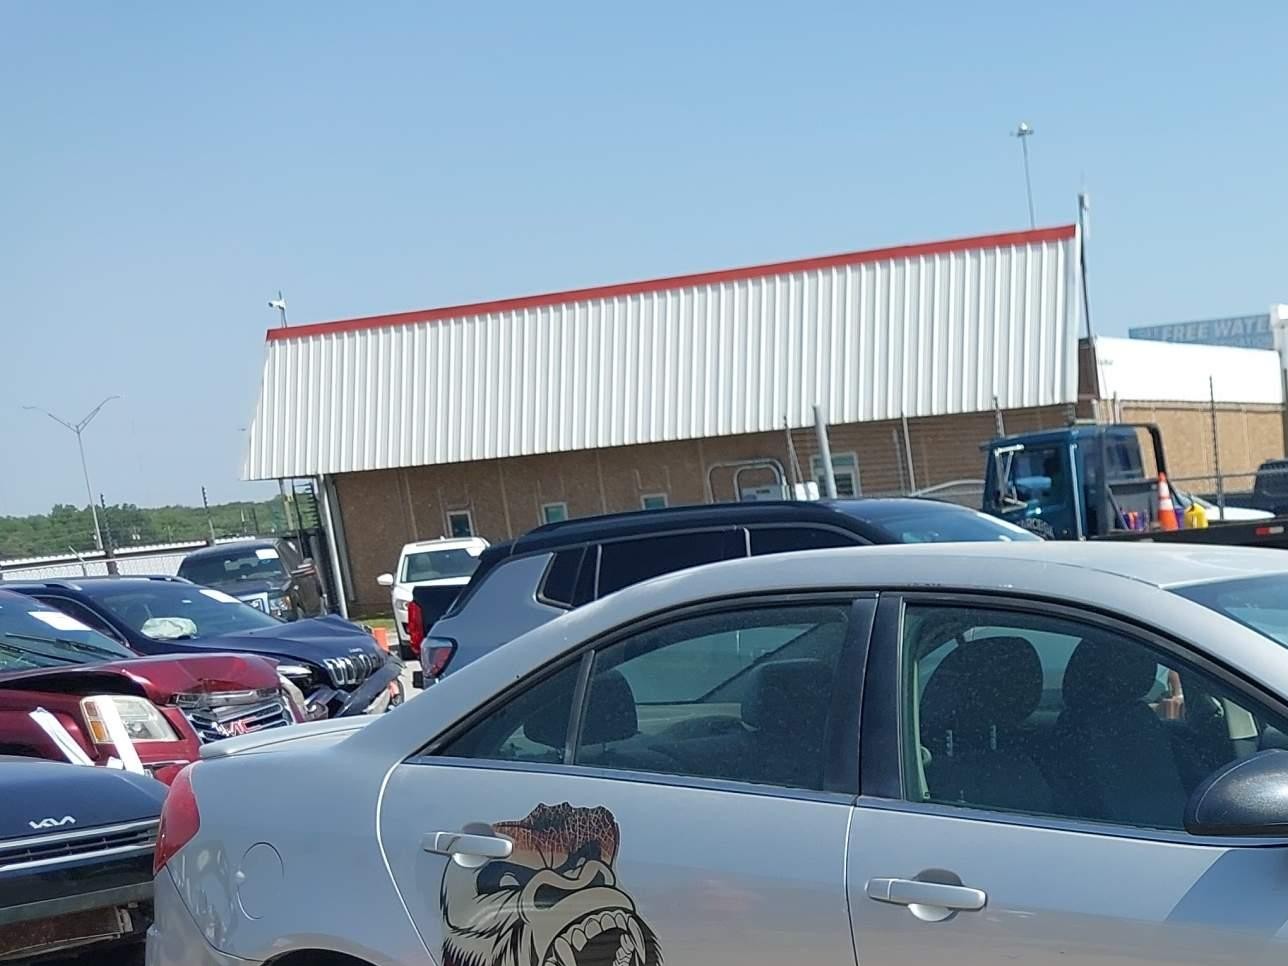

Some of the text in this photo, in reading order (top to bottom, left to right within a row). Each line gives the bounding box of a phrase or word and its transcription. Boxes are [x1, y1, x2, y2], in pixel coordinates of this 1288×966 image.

[1161, 323, 1209, 340] FREE
[1213, 317, 1269, 339] WATE
[28, 815, 76, 829] KIA
